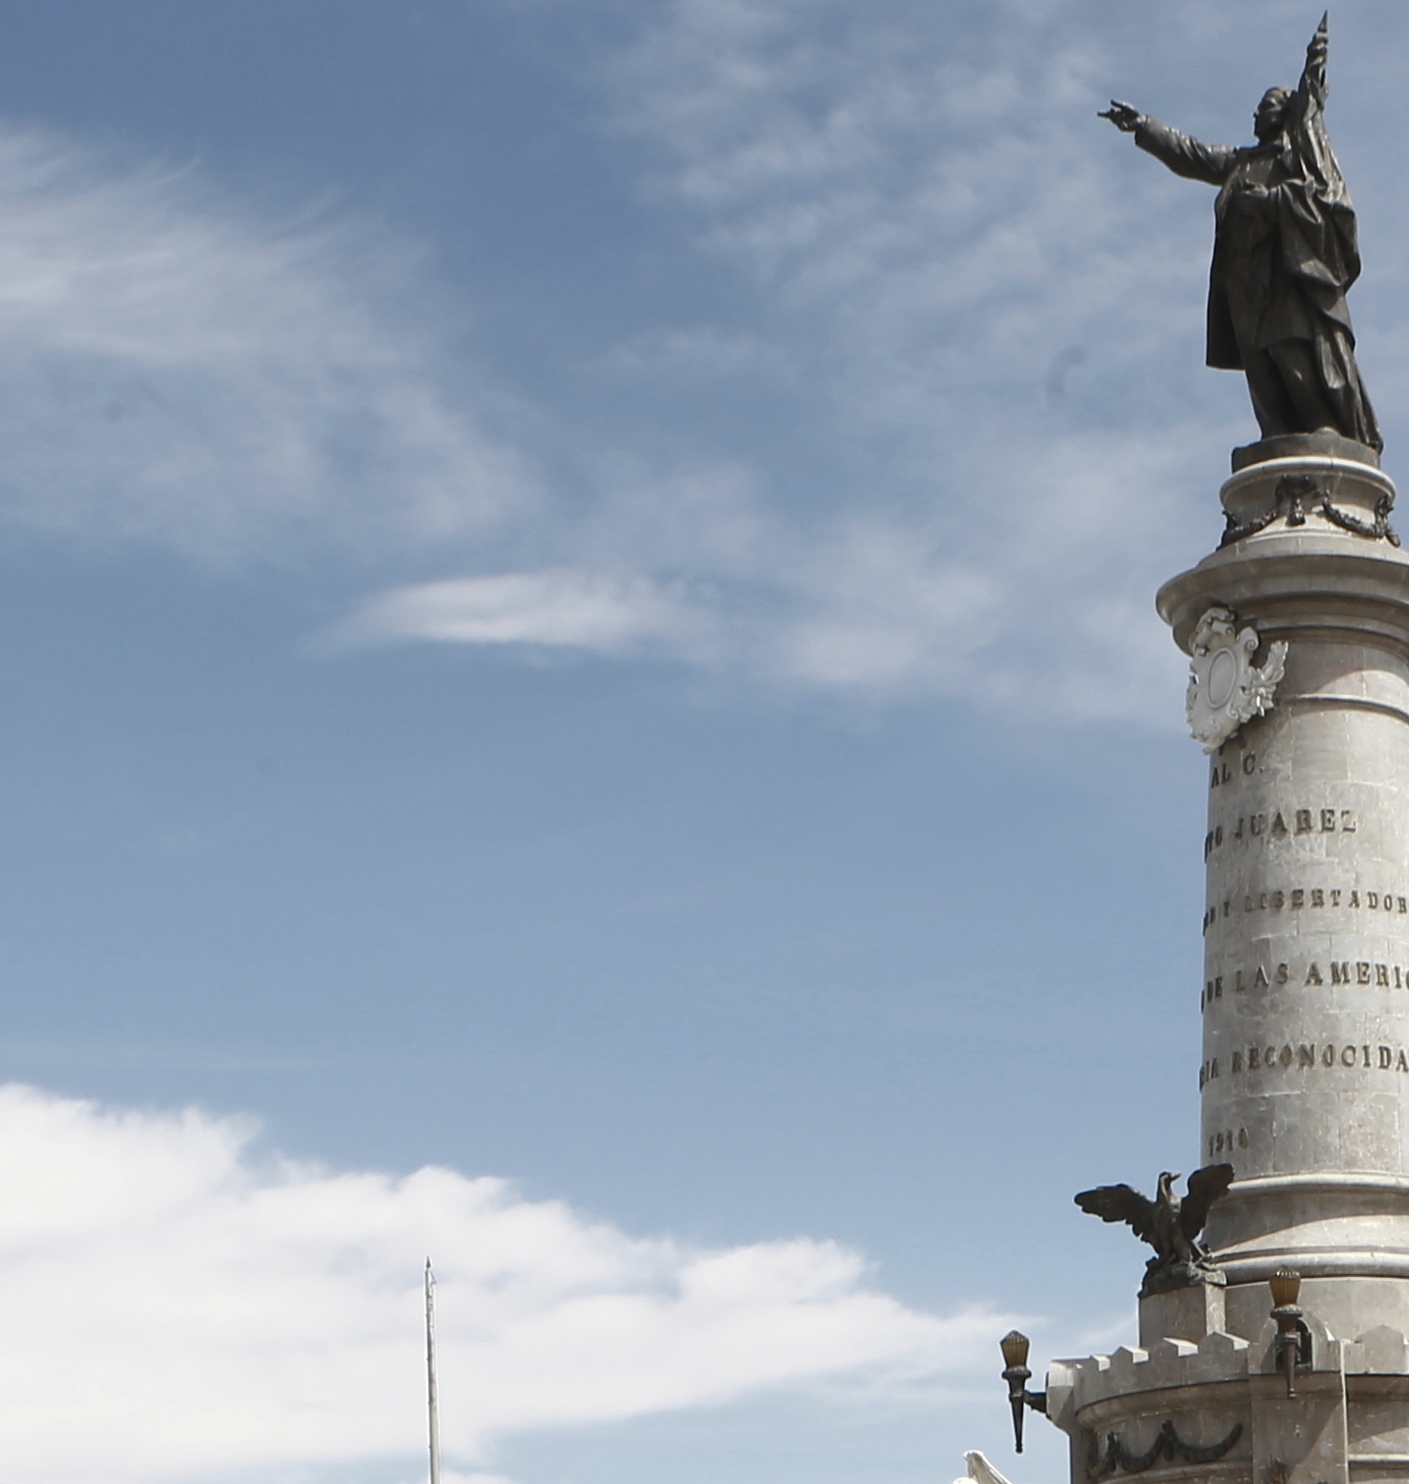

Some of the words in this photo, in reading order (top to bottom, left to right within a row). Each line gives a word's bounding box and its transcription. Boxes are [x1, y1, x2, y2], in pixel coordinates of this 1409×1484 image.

[1233, 808, 1358, 839] JUAREZ
[1244, 889, 1408, 915] LIBERTADOR
[1235, 962, 1289, 993] LAS
[1230, 1043, 1409, 1074] RECONOCIDA
[1208, 1127, 1250, 1157] 1910
